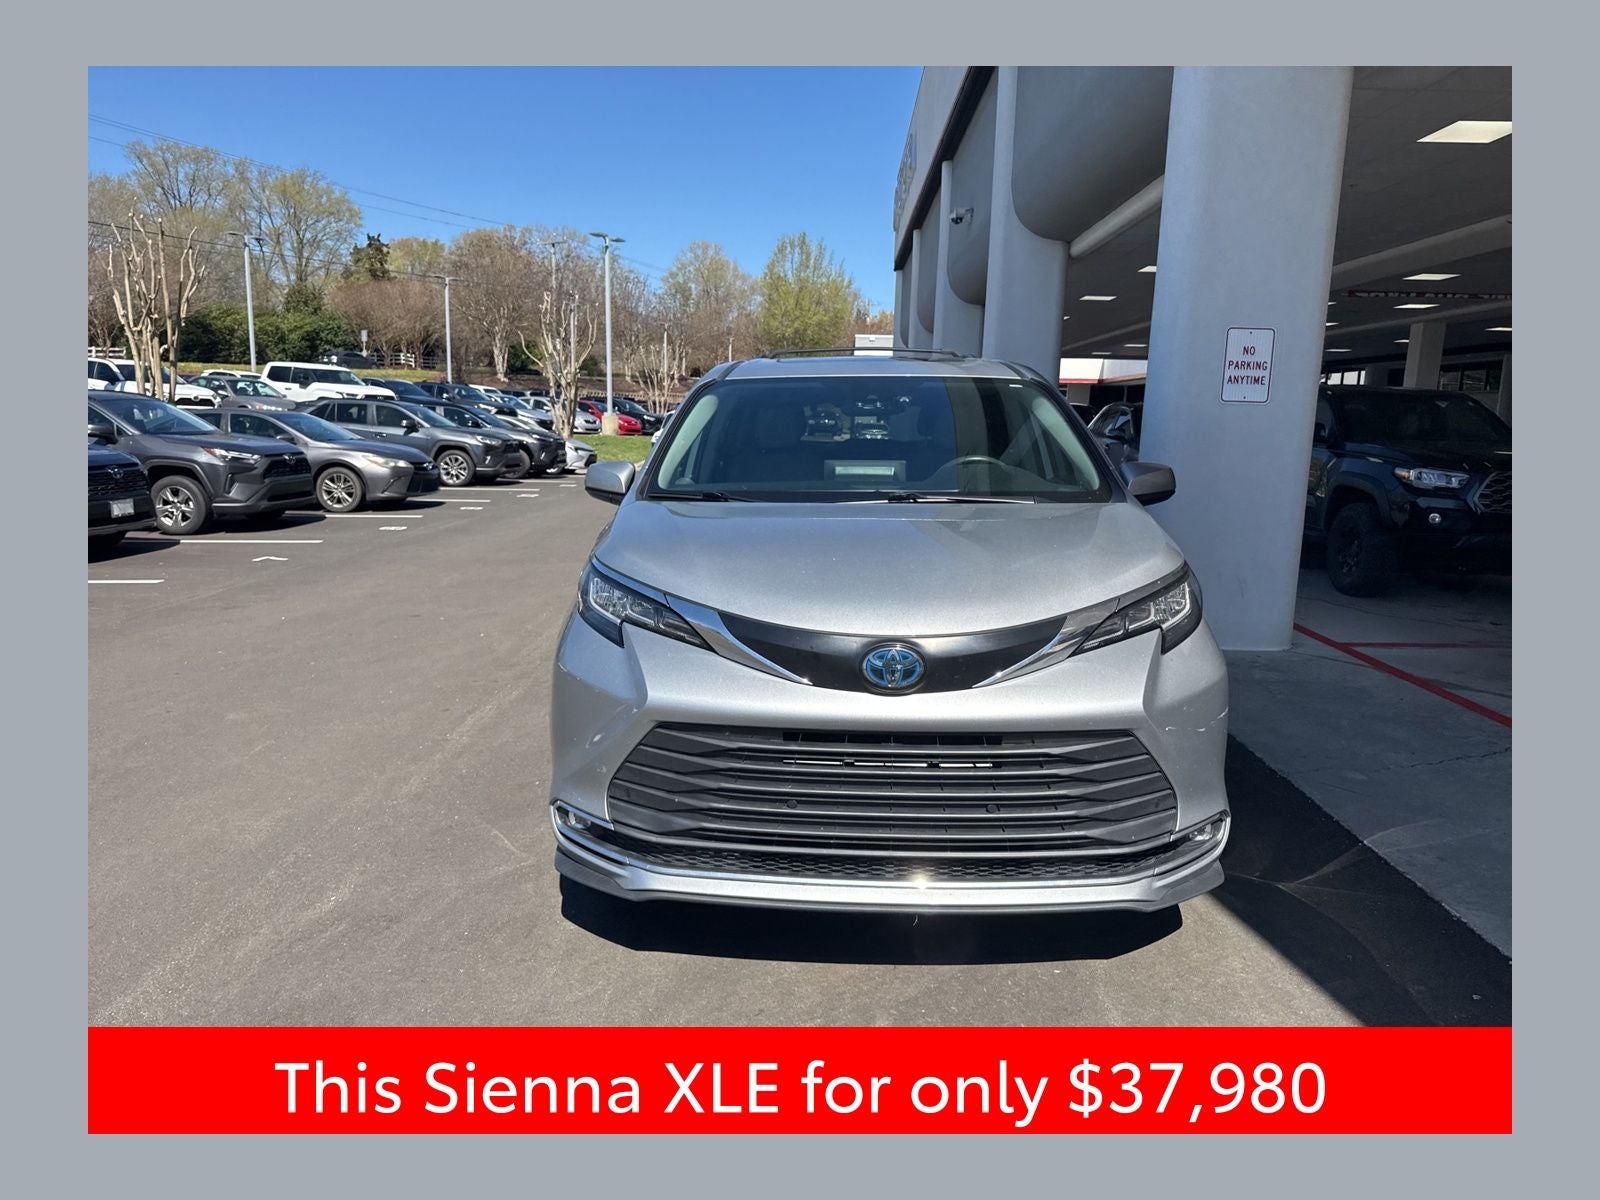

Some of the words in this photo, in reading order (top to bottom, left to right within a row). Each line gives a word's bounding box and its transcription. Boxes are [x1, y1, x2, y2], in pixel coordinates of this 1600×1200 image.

[1242, 345, 1256, 356] NO
[1227, 360, 1268, 371] PARKING
[1226, 375, 1266, 386] ANYTIME
